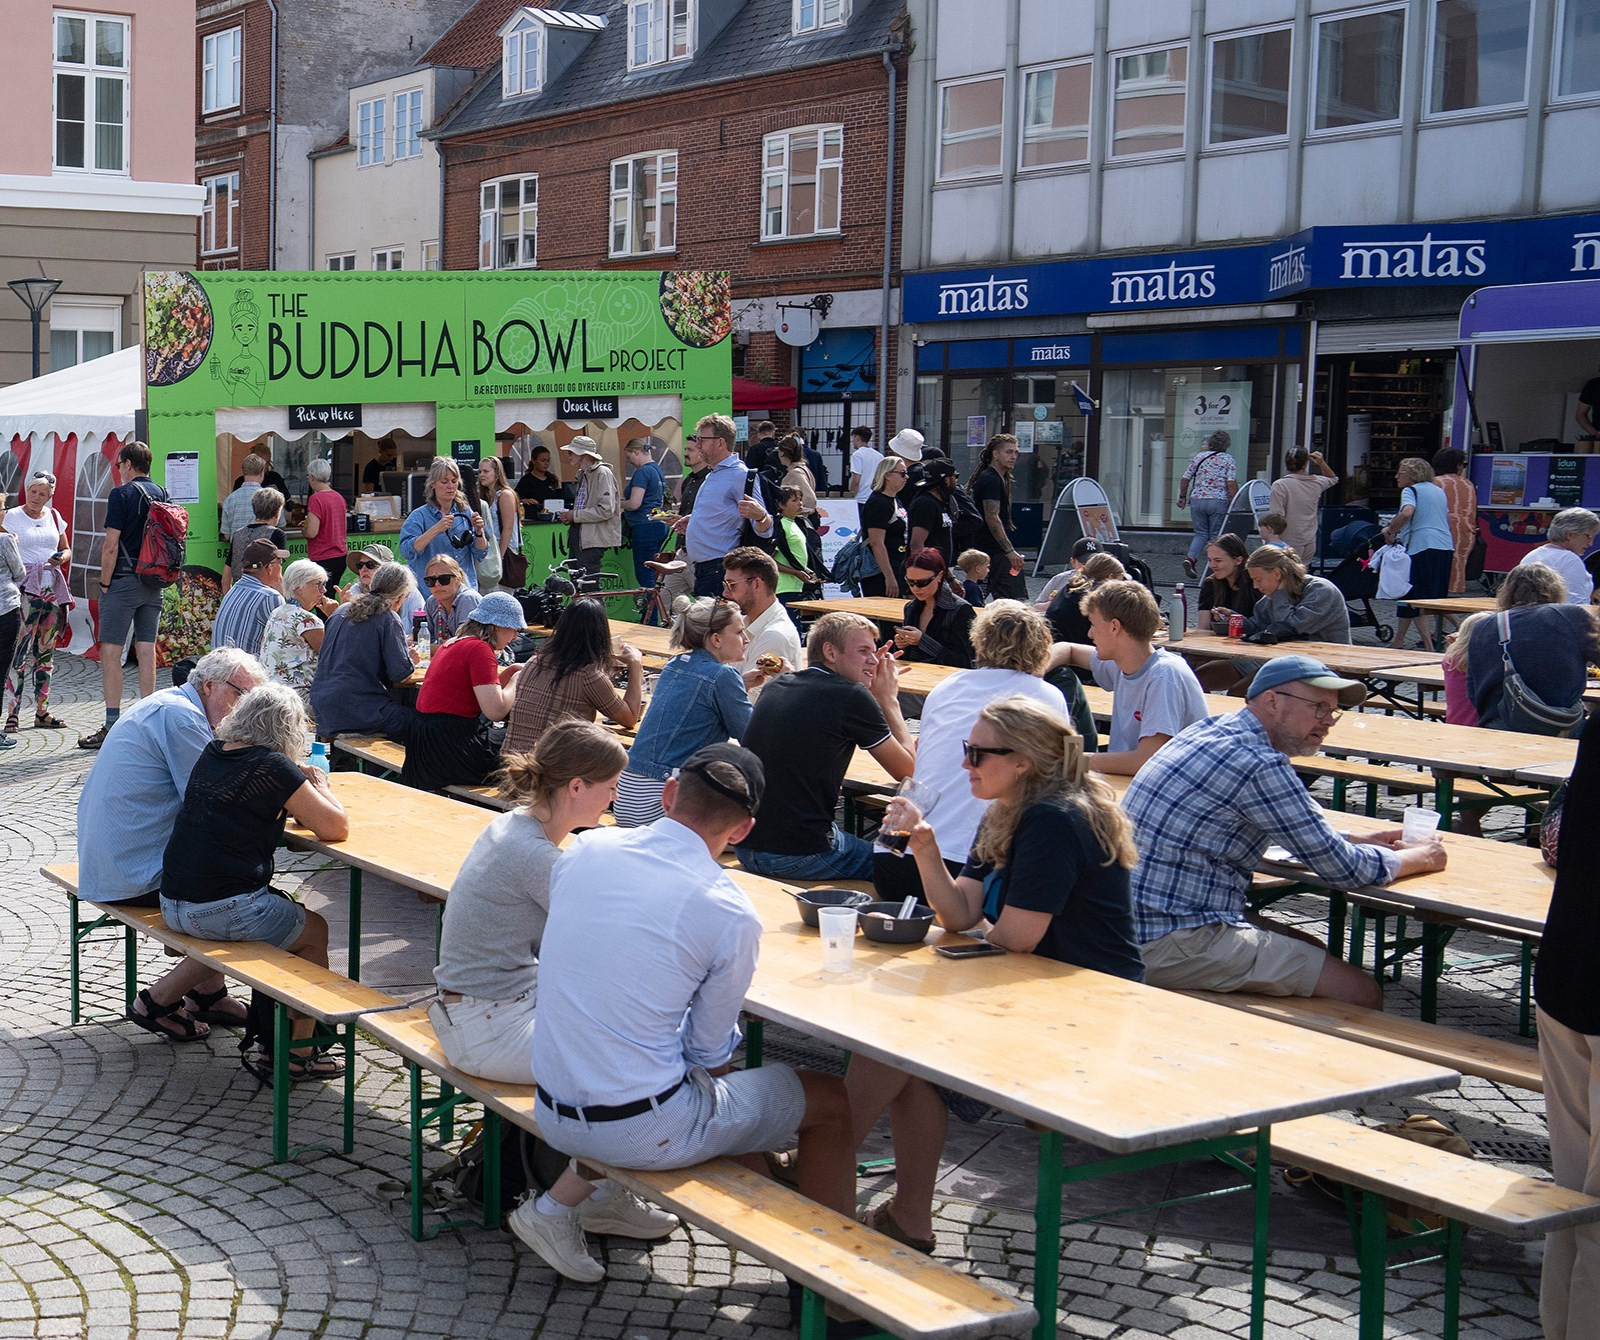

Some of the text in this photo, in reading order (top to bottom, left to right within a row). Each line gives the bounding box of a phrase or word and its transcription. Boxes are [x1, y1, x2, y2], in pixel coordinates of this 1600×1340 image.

[1338, 231, 1487, 279] matas
[1268, 243, 1306, 293] matas
[937, 273, 1029, 315] matas
[1109, 260, 1216, 304] matas
[267, 292, 309, 318] THE
[267, 318, 688, 382] BUDDHA BOWL PROJECT
[1030, 343, 1072, 362] matas
[897, 367, 909, 377] 26
[474, 384, 535, 396] BÆREDYGTIGHED,
[536, 382, 566, 394] ØKOLOGI
[567, 382, 577, 393] OG
[577, 381, 626, 393] DYREVELFÆRD
[632, 380, 646, 391] IT'S
[652, 379, 687, 391] LIFESTYLE
[1194, 394, 1232, 416] 3 for 2
[457, 442, 474, 452] idun
[1557, 458, 1577, 468] idun
